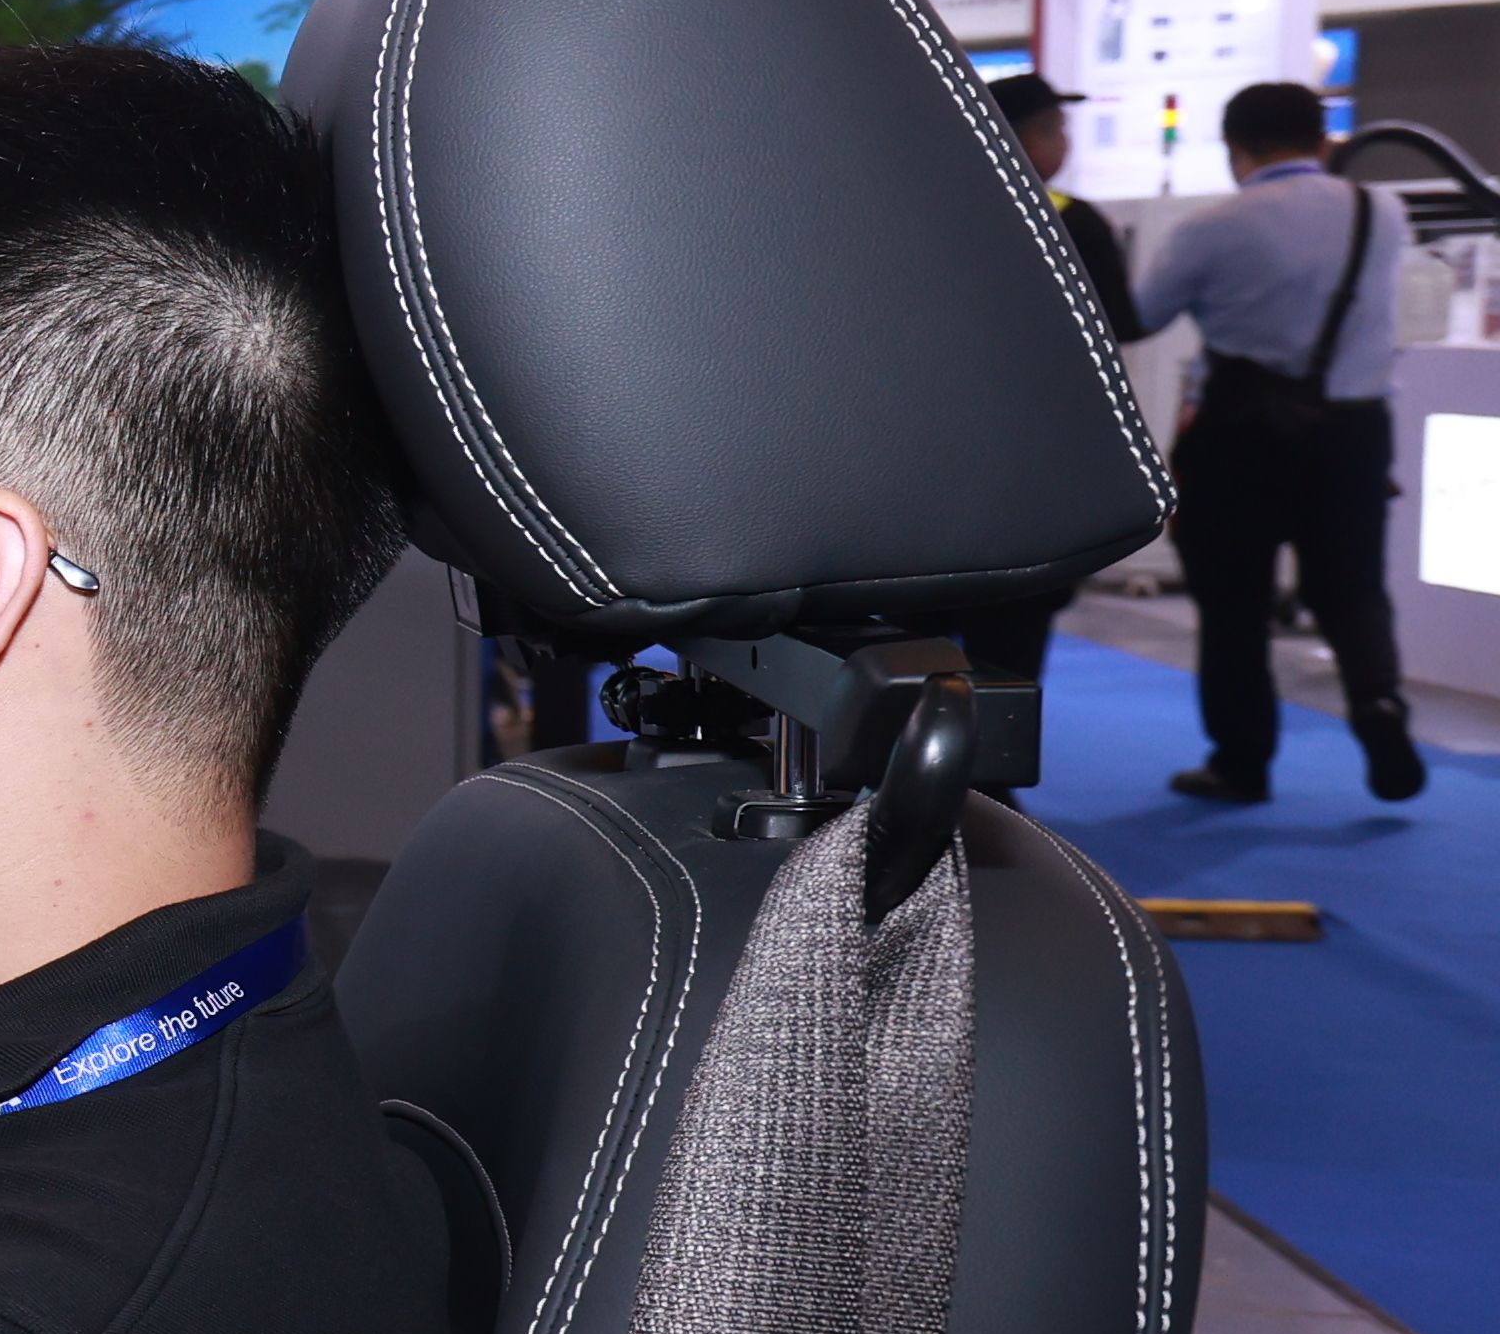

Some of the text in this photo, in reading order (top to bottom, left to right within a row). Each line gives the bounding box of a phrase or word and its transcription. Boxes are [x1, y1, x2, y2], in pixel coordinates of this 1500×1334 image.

[53, 979, 245, 1086] Explore the future
